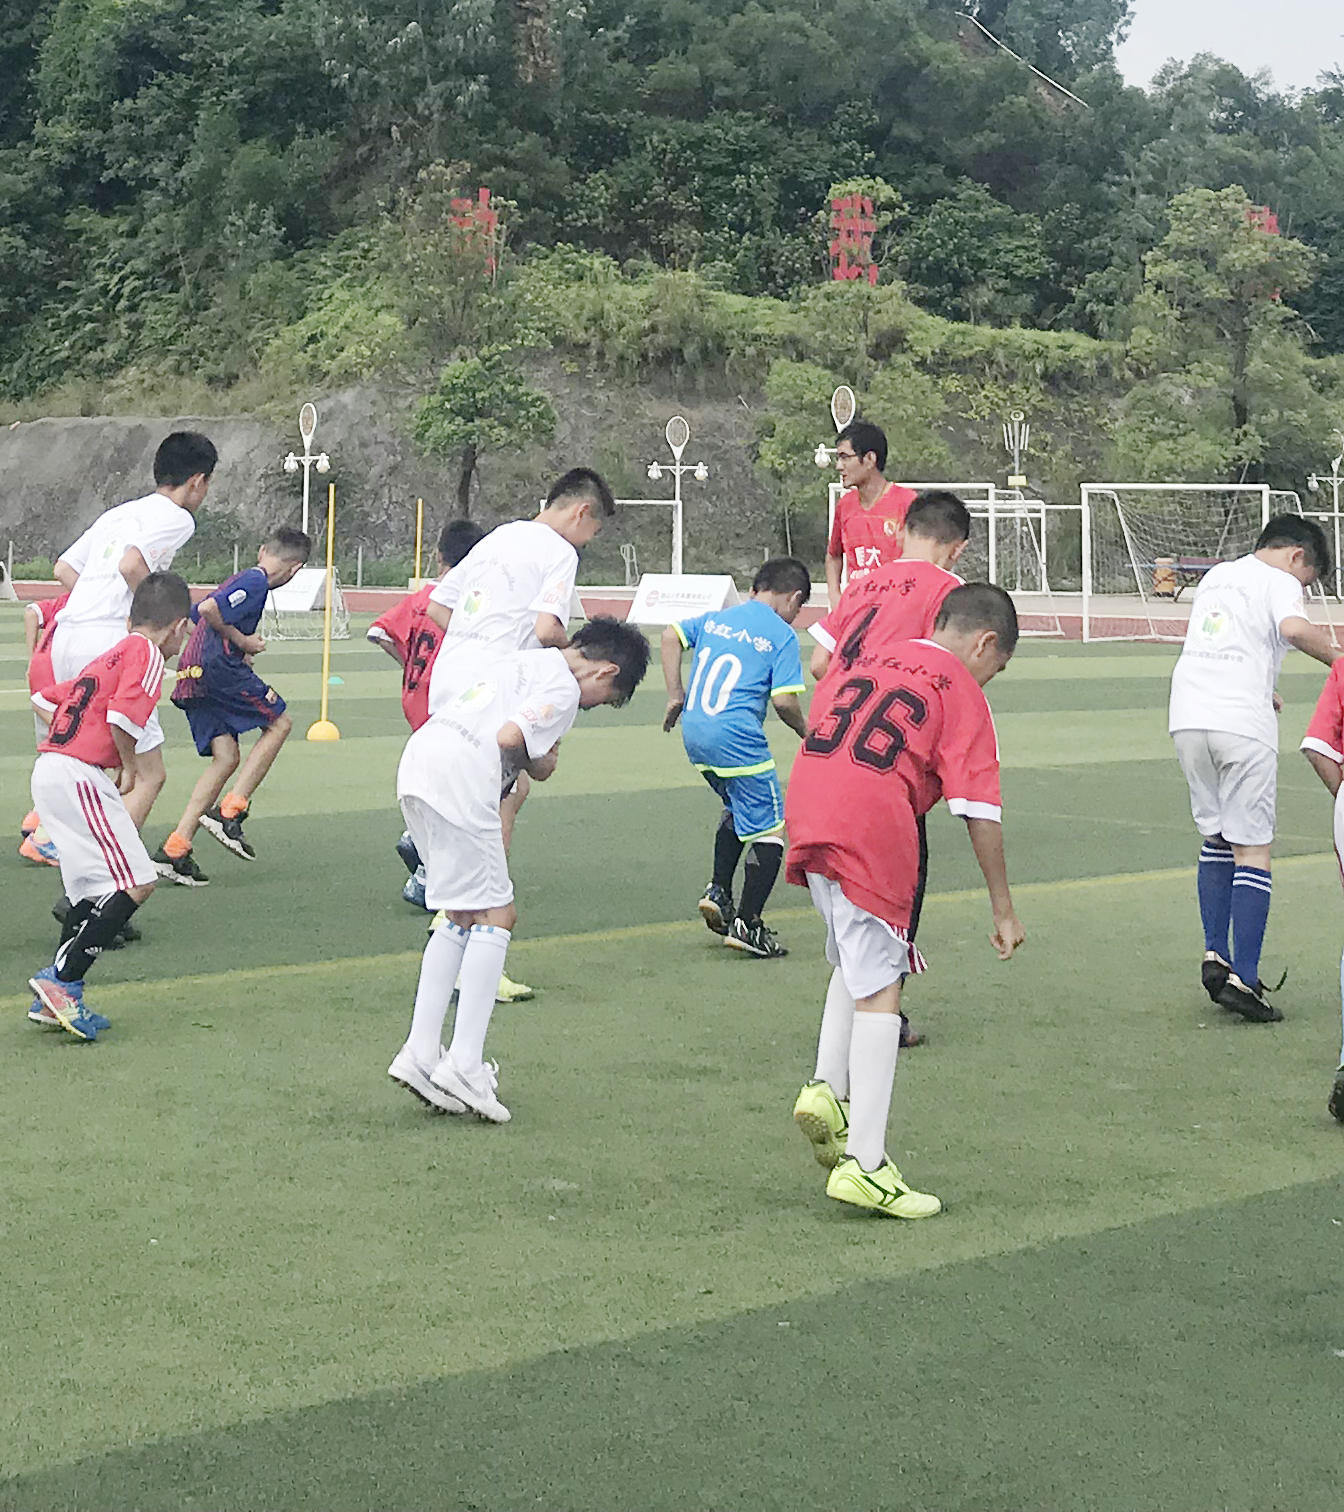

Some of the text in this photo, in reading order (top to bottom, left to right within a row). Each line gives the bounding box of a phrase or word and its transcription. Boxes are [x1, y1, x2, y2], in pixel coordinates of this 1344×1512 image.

[48, 674, 100, 748] 3
[686, 646, 742, 717] 10
[802, 675, 929, 775] 36
